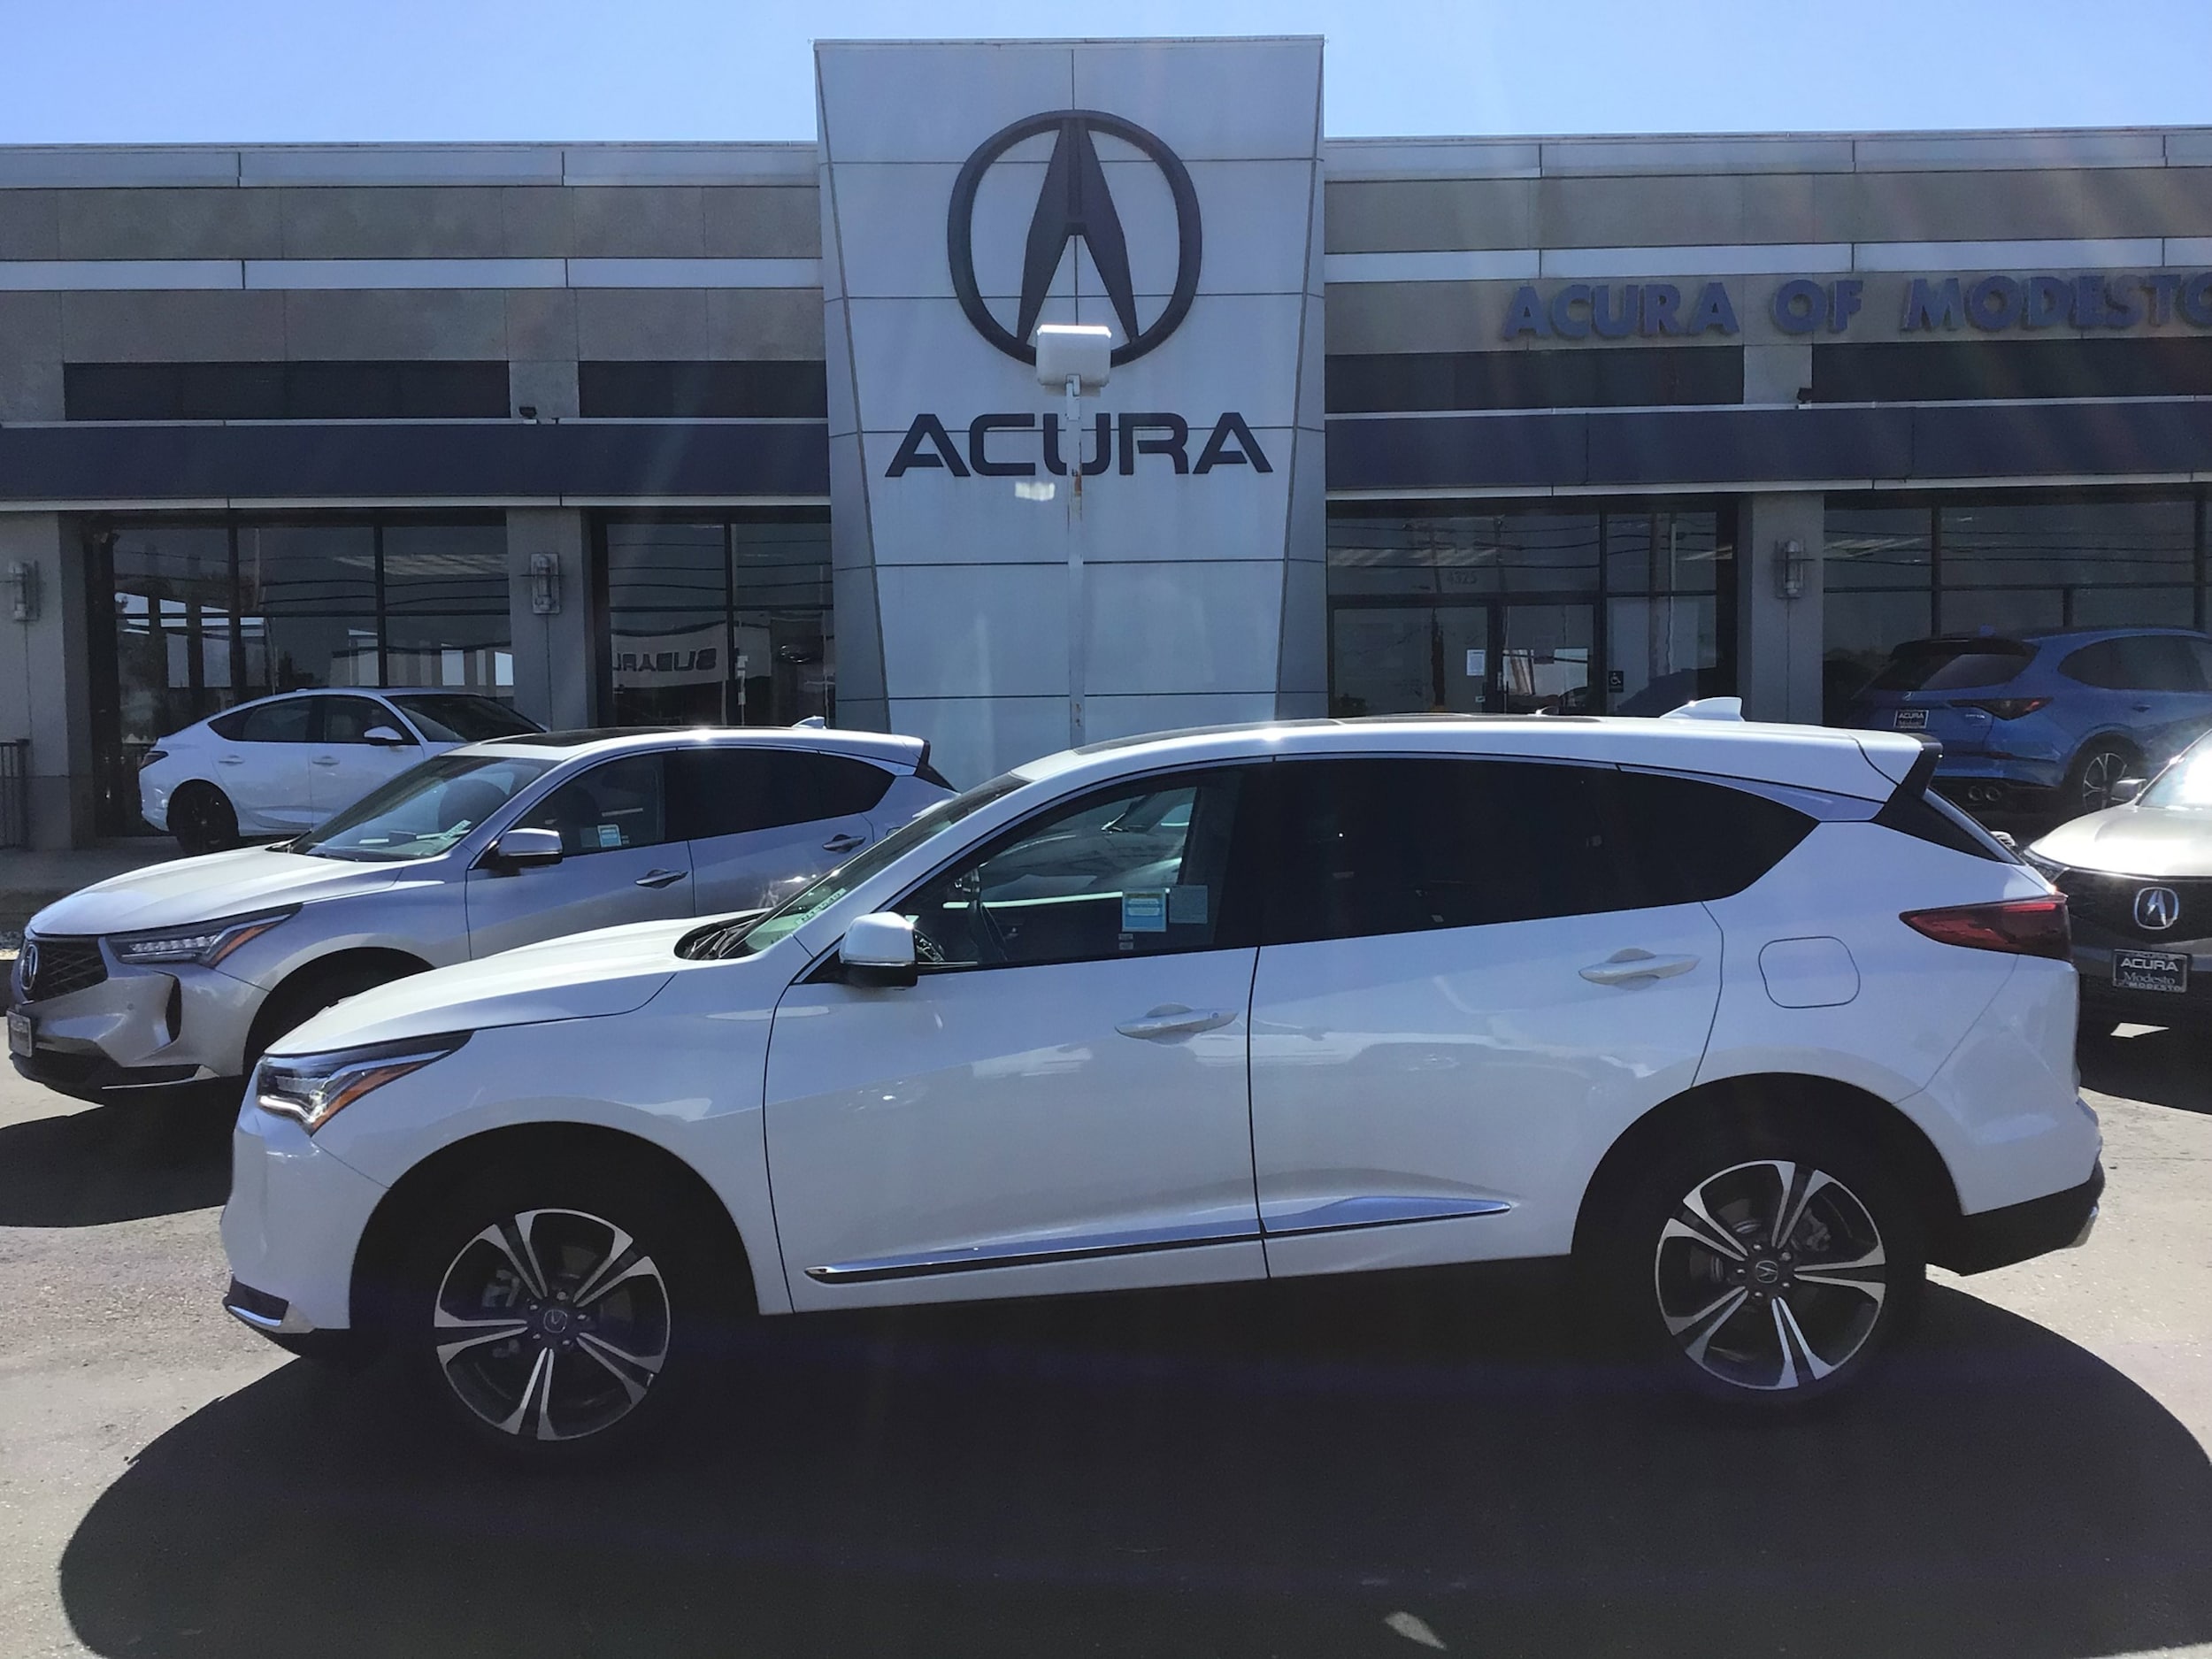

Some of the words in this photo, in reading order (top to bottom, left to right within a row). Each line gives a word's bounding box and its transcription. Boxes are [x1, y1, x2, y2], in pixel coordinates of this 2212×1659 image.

[1502, 281, 1740, 340] ACURA
[1772, 279, 1863, 334] OF
[885, 412, 1274, 478] ACURA
[2121, 958, 2178, 972] ACURA
[2124, 972, 2175, 984] Modesto
